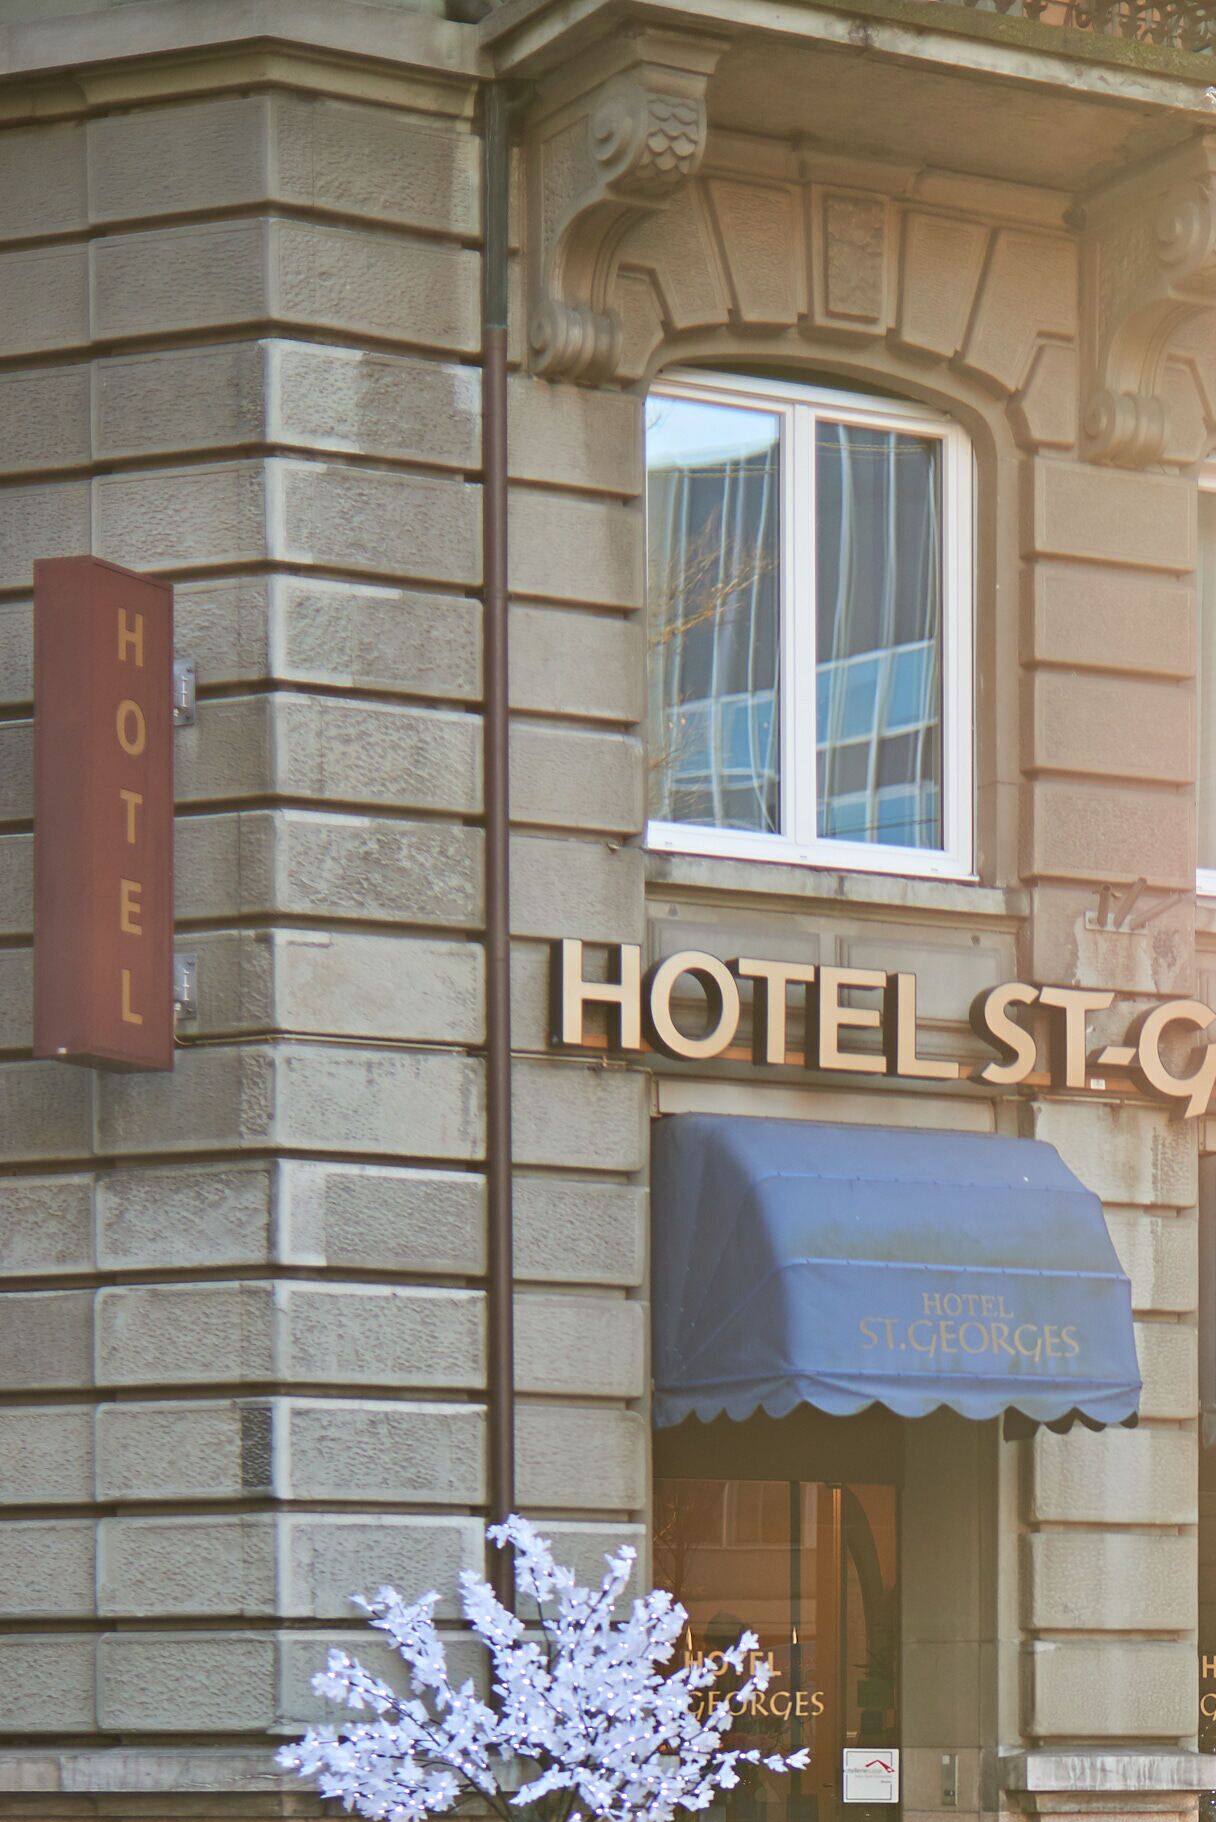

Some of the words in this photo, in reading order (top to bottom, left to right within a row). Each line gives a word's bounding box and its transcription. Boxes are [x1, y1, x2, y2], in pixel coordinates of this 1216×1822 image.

[116, 608, 146, 1025] HOTEL
[560, 938, 960, 1080] HOTEL
[922, 1291, 1014, 1319] HOTEL
[684, 1650, 782, 1676] HOEL
